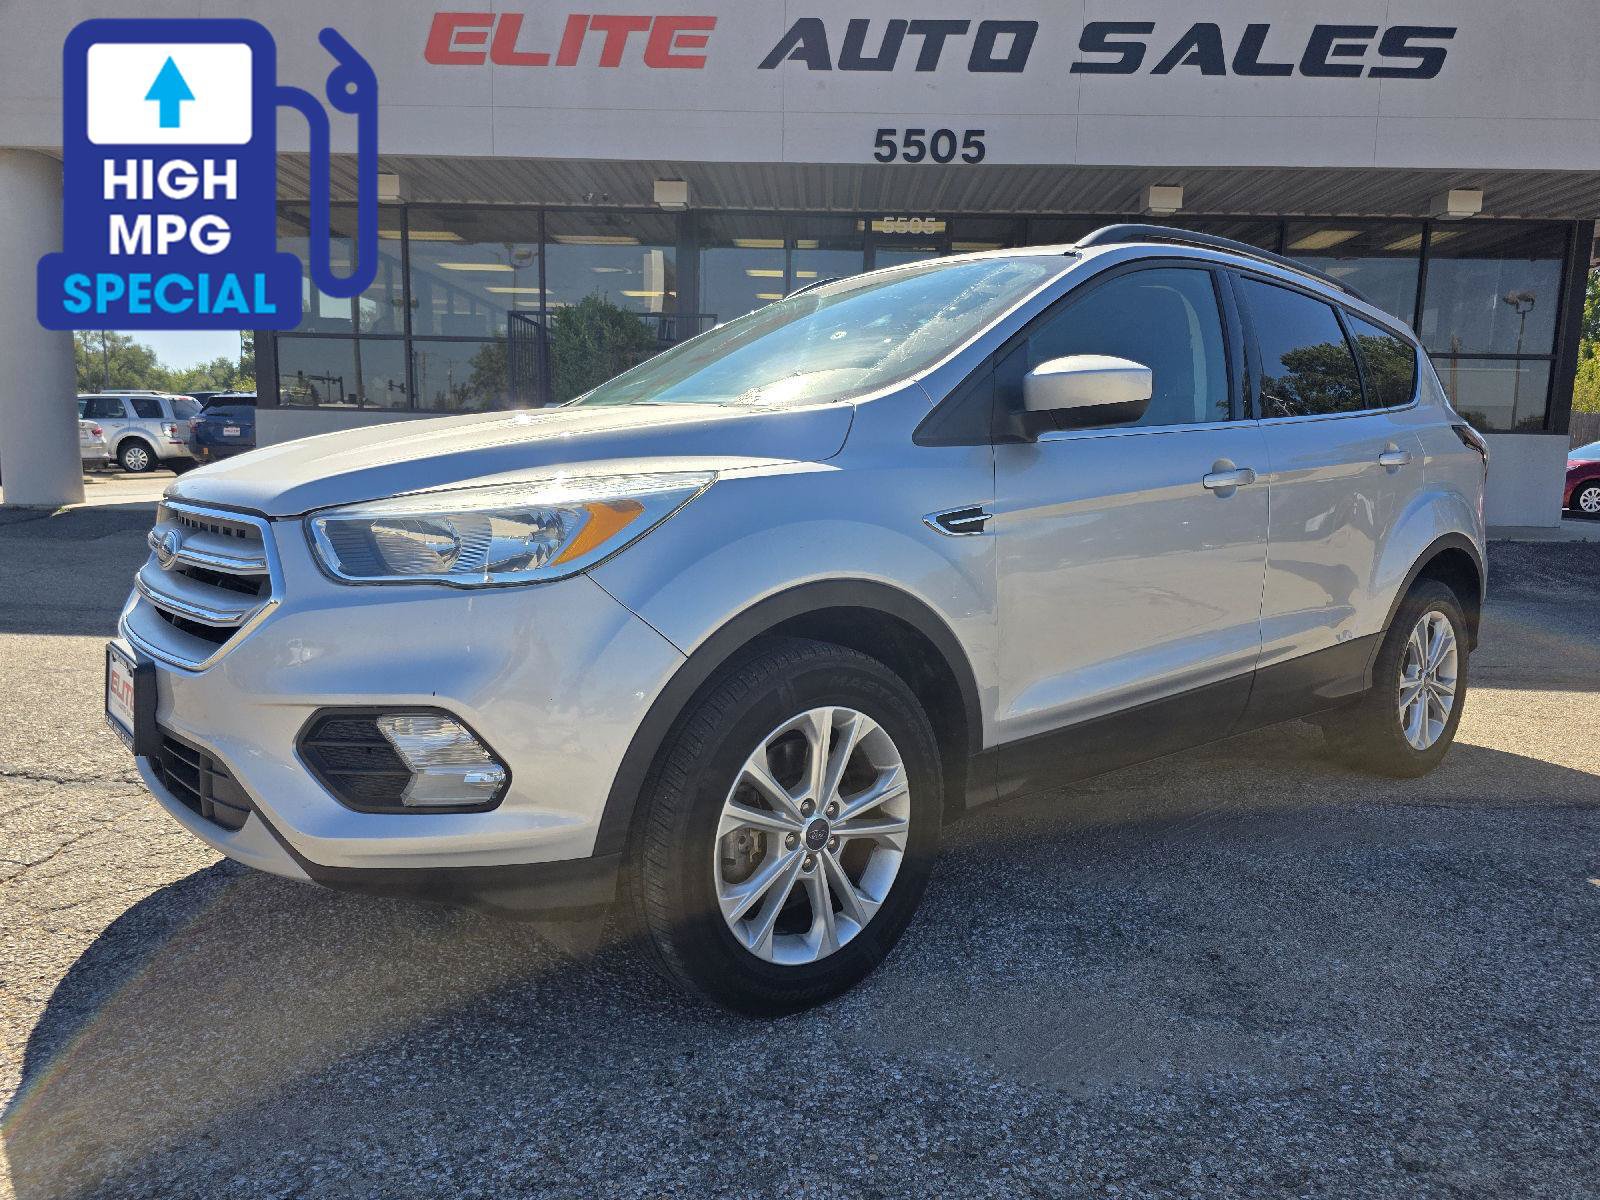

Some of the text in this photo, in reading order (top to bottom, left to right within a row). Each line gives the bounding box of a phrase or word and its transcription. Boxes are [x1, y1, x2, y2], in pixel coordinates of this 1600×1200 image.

[425, 12, 1457, 79] ELITE AUTO SALES
[874, 128, 986, 164] 5505
[882, 216, 936, 234] 5505
